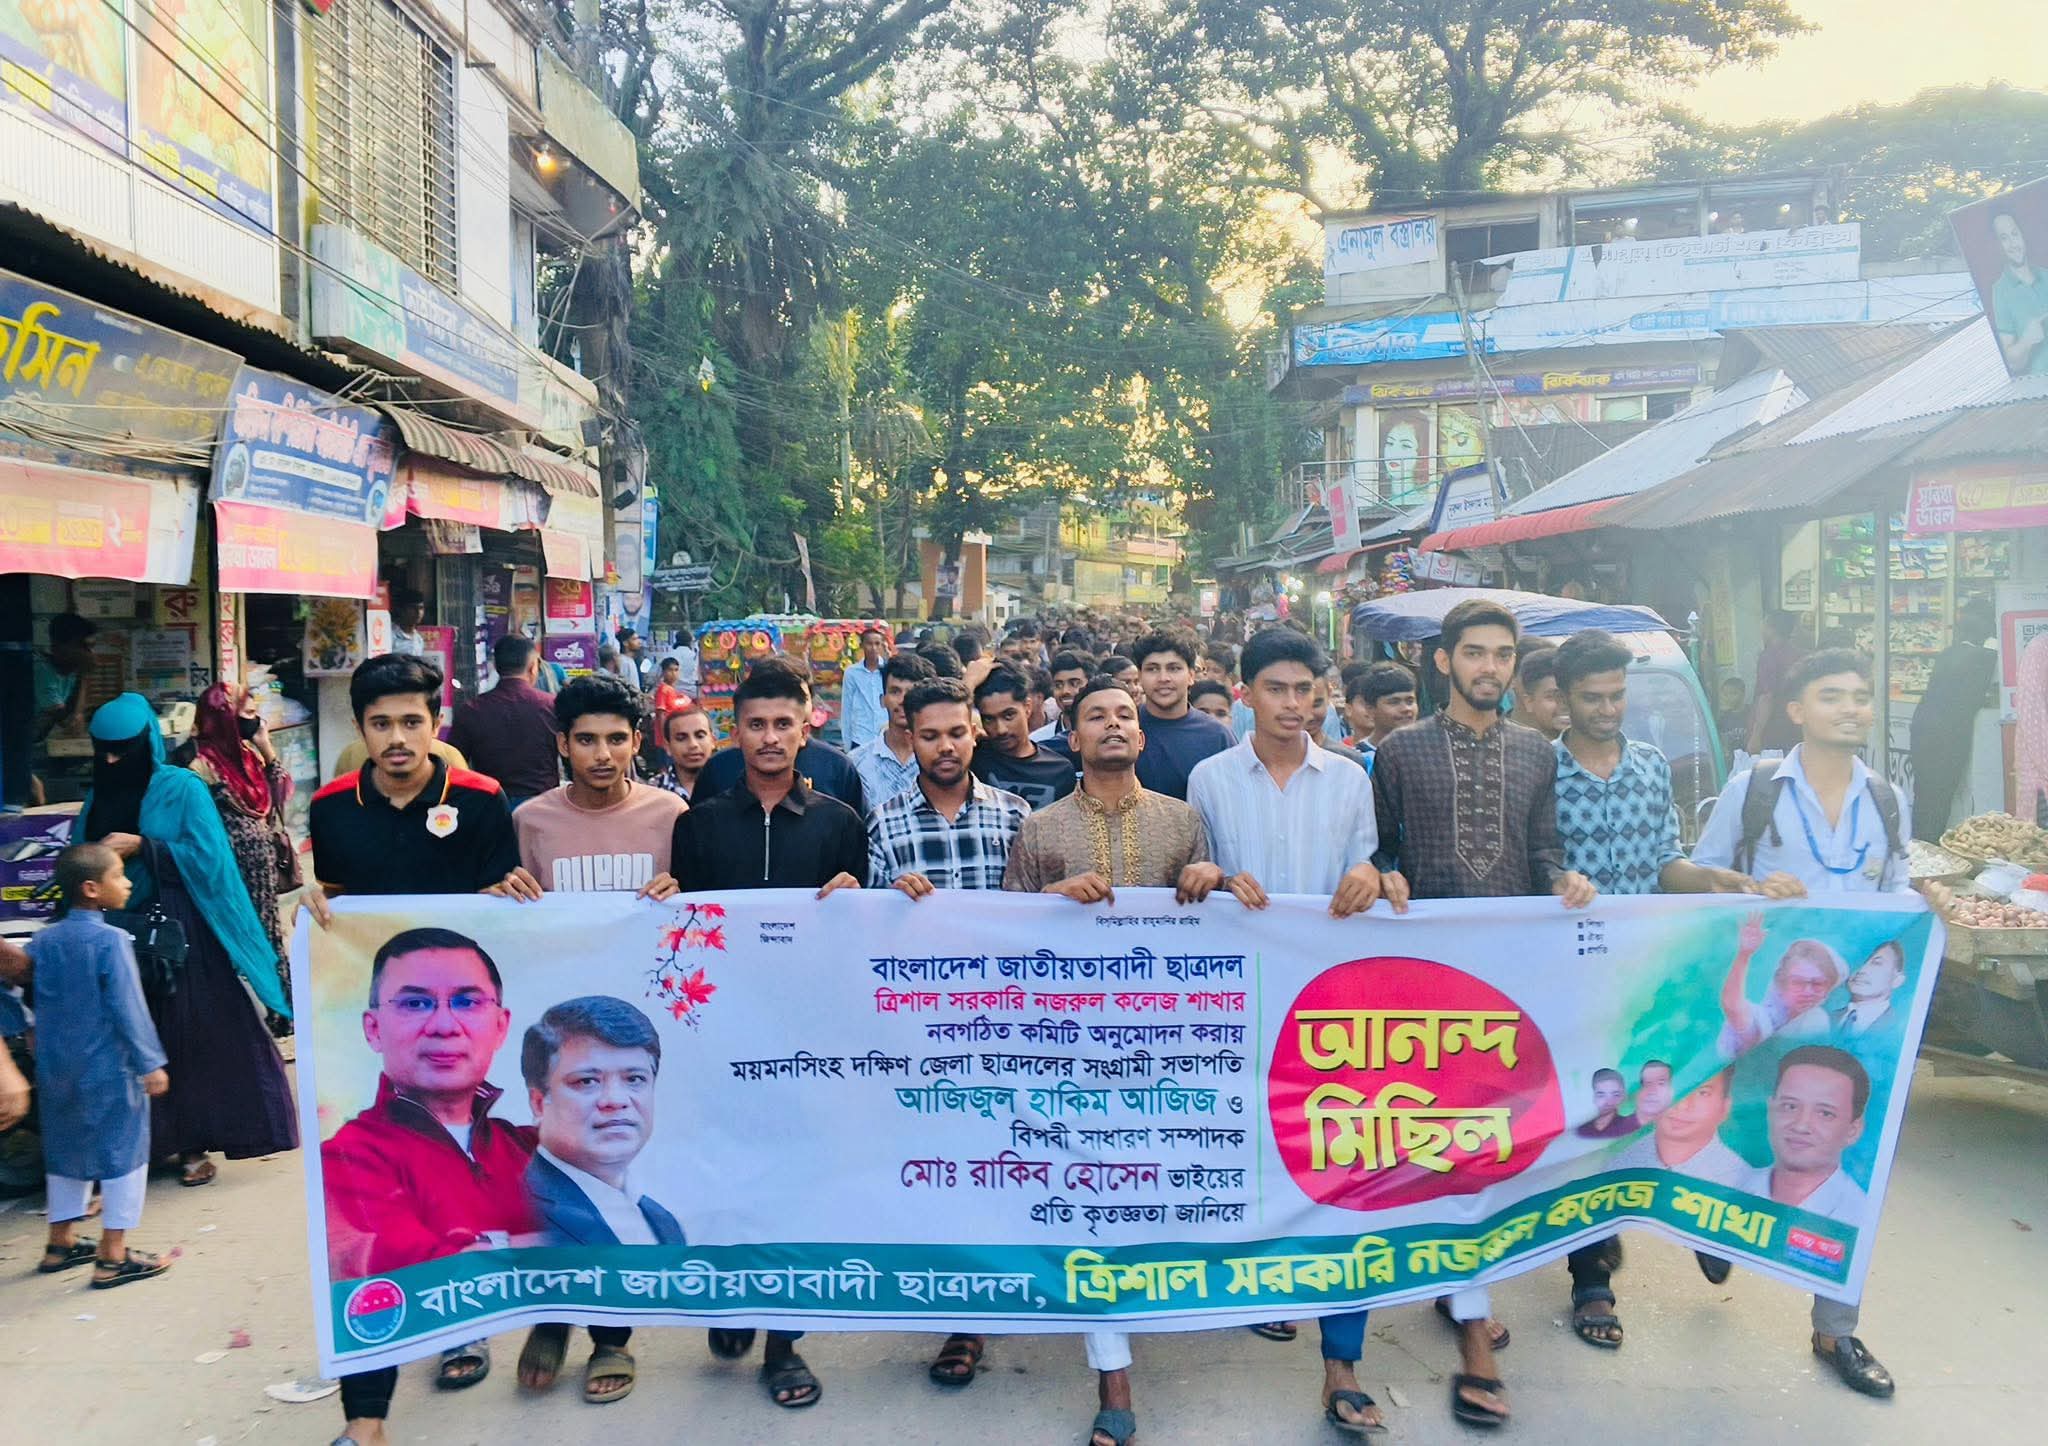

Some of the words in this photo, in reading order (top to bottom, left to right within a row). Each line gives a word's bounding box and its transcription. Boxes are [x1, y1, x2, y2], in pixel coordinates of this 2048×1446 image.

[1337, 225, 1385, 260] এনামুল
[1389, 215, 1436, 250] বস্ত্রালয়
[1916, 506, 1955, 526] ডাবল
[869, 954, 989, 982] বাংলাদেশ
[995, 947, 1157, 981] জাতীয়তাবাদী
[1163, 953, 1246, 982] ছাত্রদল
[874, 987, 941, 1013] ত্রিশাল
[947, 985, 1027, 1010] সরকারি
[1032, 993, 1107, 1013] নজরুল
[1112, 993, 1180, 1012] কলেজ
[1185, 991, 1246, 1012] শাখার
[925, 1015, 1014, 1043] নবগঠিত
[1018, 1018, 1082, 1045] কমিটি
[1087, 1024, 1185, 1048] অনুমোদন
[1189, 1022, 1247, 1044] করায়
[1296, 1009, 1523, 1069] আনন্দ
[729, 1053, 845, 1081] ময়মনসিংহ
[850, 1050, 912, 1076] দক্ষিণ
[920, 1053, 974, 1076] জেলা
[979, 1052, 1076, 1077] ছাত্রদলের
[1081, 1047, 1154, 1080] সংগ্রামী
[1160, 1051, 1245, 1075] সভাপতি
[894, 1079, 1019, 1122] আজিজুল
[1026, 1080, 1111, 1119] হাকিম
[1118, 1078, 1219, 1115] আজিজ
[1226, 1096, 1243, 1114] ও
[1077, 1127, 1152, 1150] সাধারণ
[1157, 1127, 1246, 1149] সম্পাদক
[1306, 1082, 1510, 1172] মিছিল
[901, 1157, 957, 1188] মোঃ
[967, 1150, 1053, 1189] রাকিব
[1064, 1160, 1162, 1196] হোসেন
[1167, 1163, 1246, 1191] ভাইয়ের
[1030, 1197, 1076, 1225] প্রতি
[1080, 1204, 1169, 1236] কৃতজ্ঞতা
[1174, 1198, 1248, 1224] জানিয়ে
[416, 1264, 607, 1317] বাংলাদেশ
[619, 1259, 882, 1299] জাতীয়তাবাদী
[894, 1269, 1045, 1304] ছাত্রদল,
[1065, 1249, 1206, 1303] ত্রিশাল
[1224, 1234, 1395, 1295] সরকারি
[1406, 1210, 1544, 1277] নজরুল
[1544, 1178, 1659, 1229] কলেজ
[1671, 1186, 1777, 1249] শাখা
